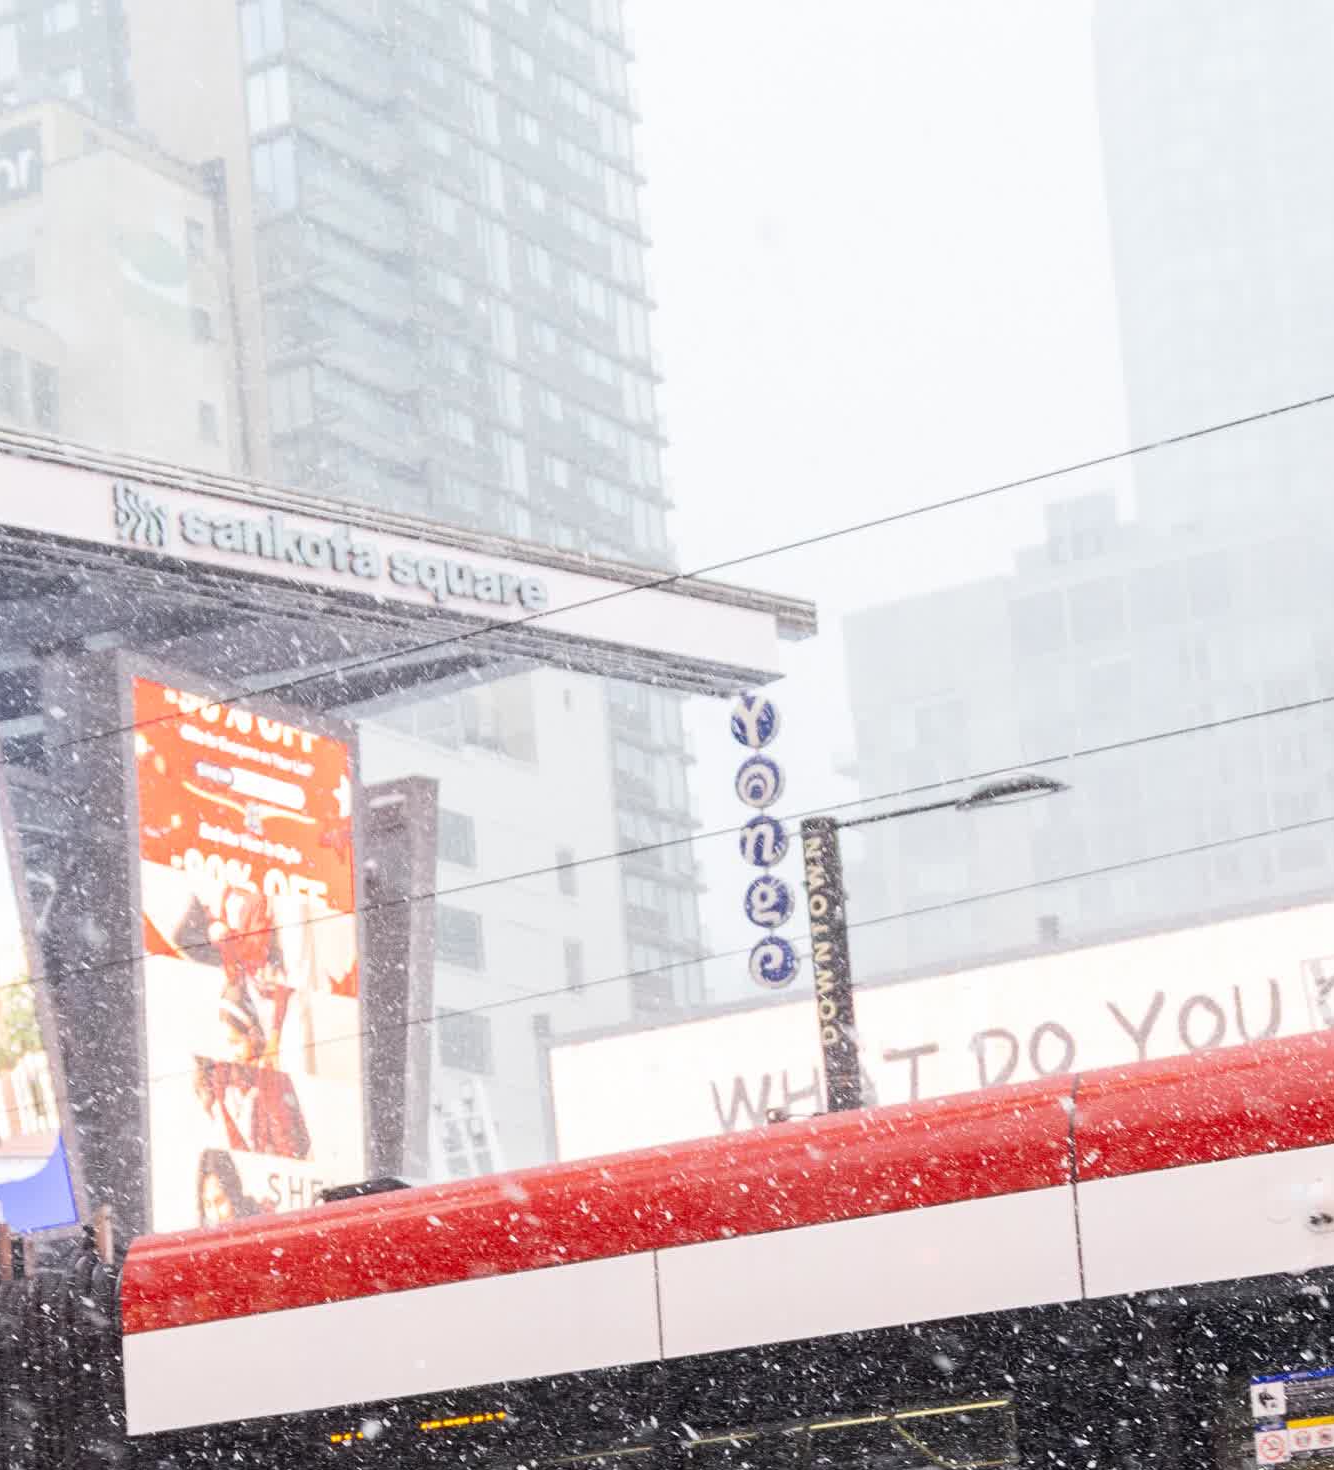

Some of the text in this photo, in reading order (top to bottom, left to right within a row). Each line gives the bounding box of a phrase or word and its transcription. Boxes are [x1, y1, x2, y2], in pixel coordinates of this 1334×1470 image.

[180, 507, 549, 610] sankofa square
[711, 1042, 938, 1133] WHT
[971, 1020, 1077, 1089] DO
[1107, 978, 1282, 1064] YOU
